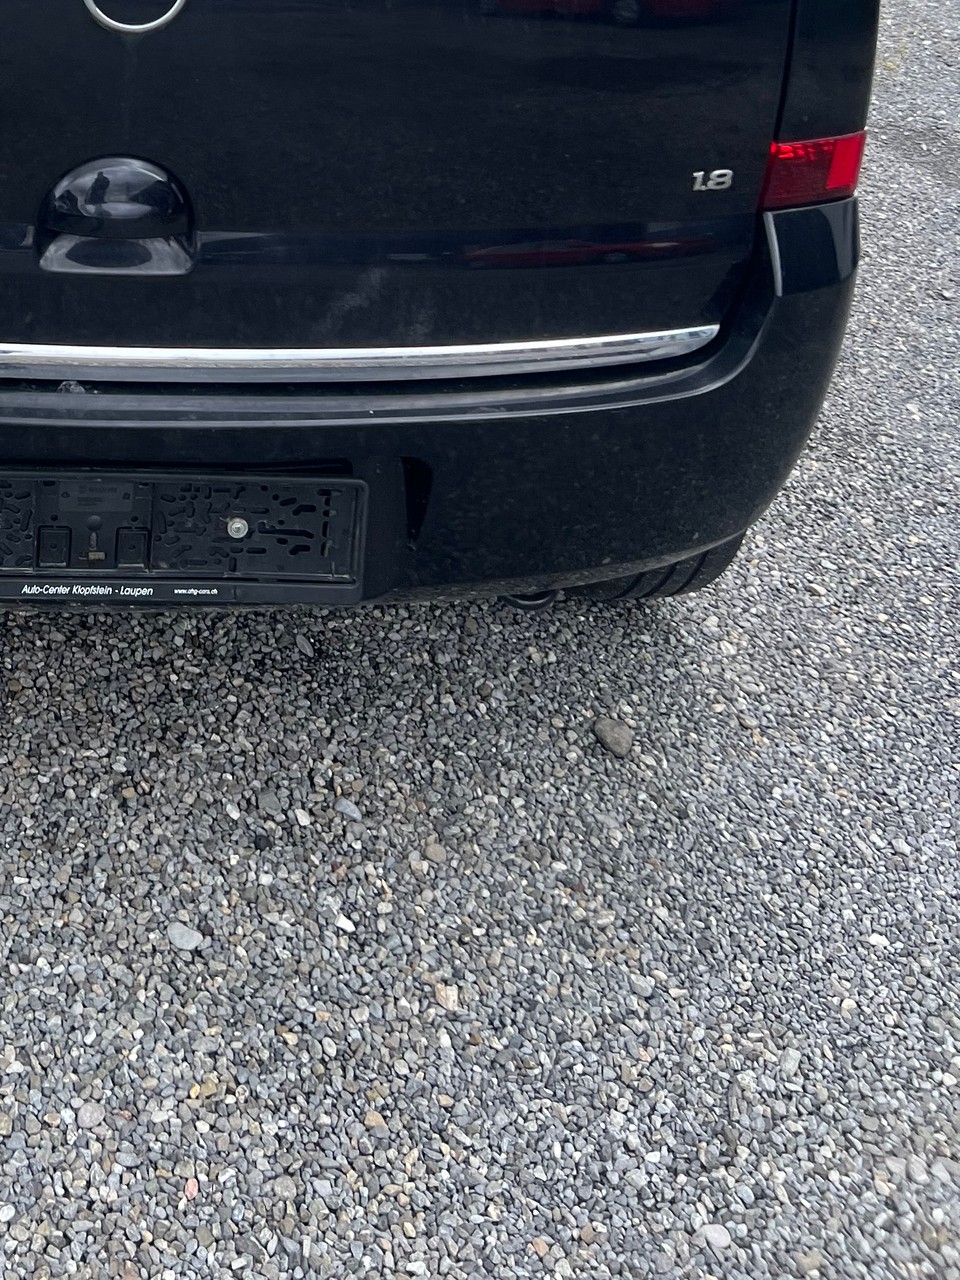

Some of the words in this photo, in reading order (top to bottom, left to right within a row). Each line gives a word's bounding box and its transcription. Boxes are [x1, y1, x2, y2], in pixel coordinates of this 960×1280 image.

[21, 584, 71, 595] Auto-Center
[72, 585, 113, 597] Klopfstein
[120, 585, 154, 597] Laupen
